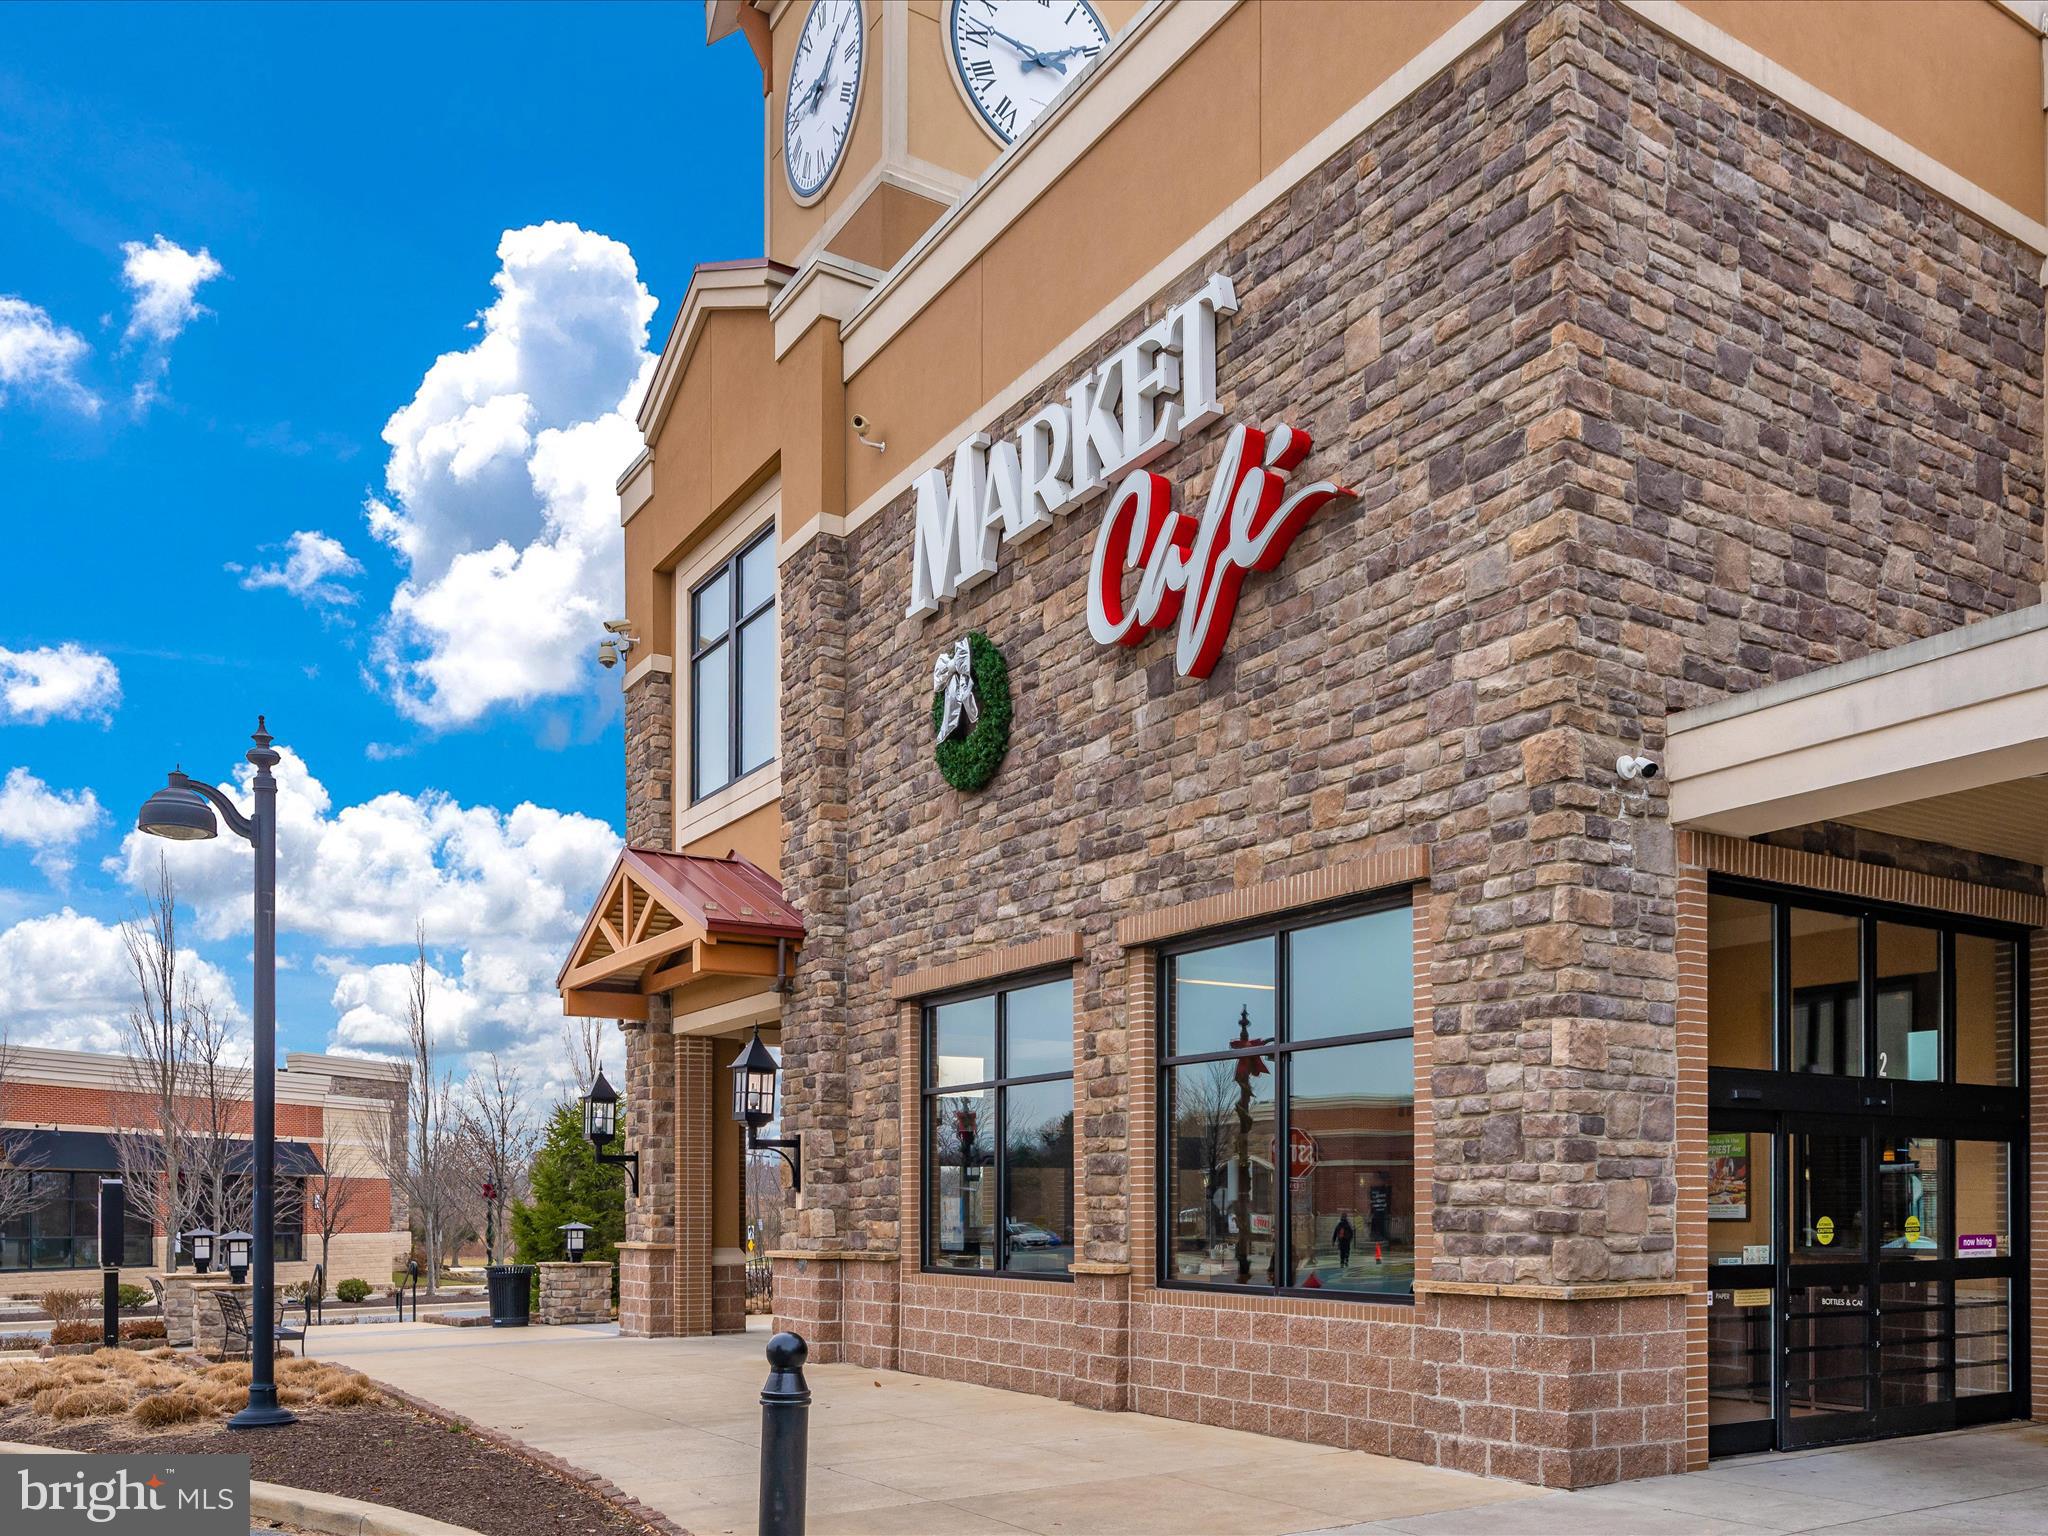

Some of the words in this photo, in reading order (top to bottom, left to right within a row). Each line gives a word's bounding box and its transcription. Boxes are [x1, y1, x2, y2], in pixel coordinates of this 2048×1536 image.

[905, 271, 1240, 620] MARKET
[1087, 422, 1354, 679] Café
[1879, 1052, 1888, 1077] 2
[1976, 1236, 1993, 1248] hiring
[1821, 1297, 1845, 1306] BOTTLES
[1846, 1298, 1851, 1306] &
